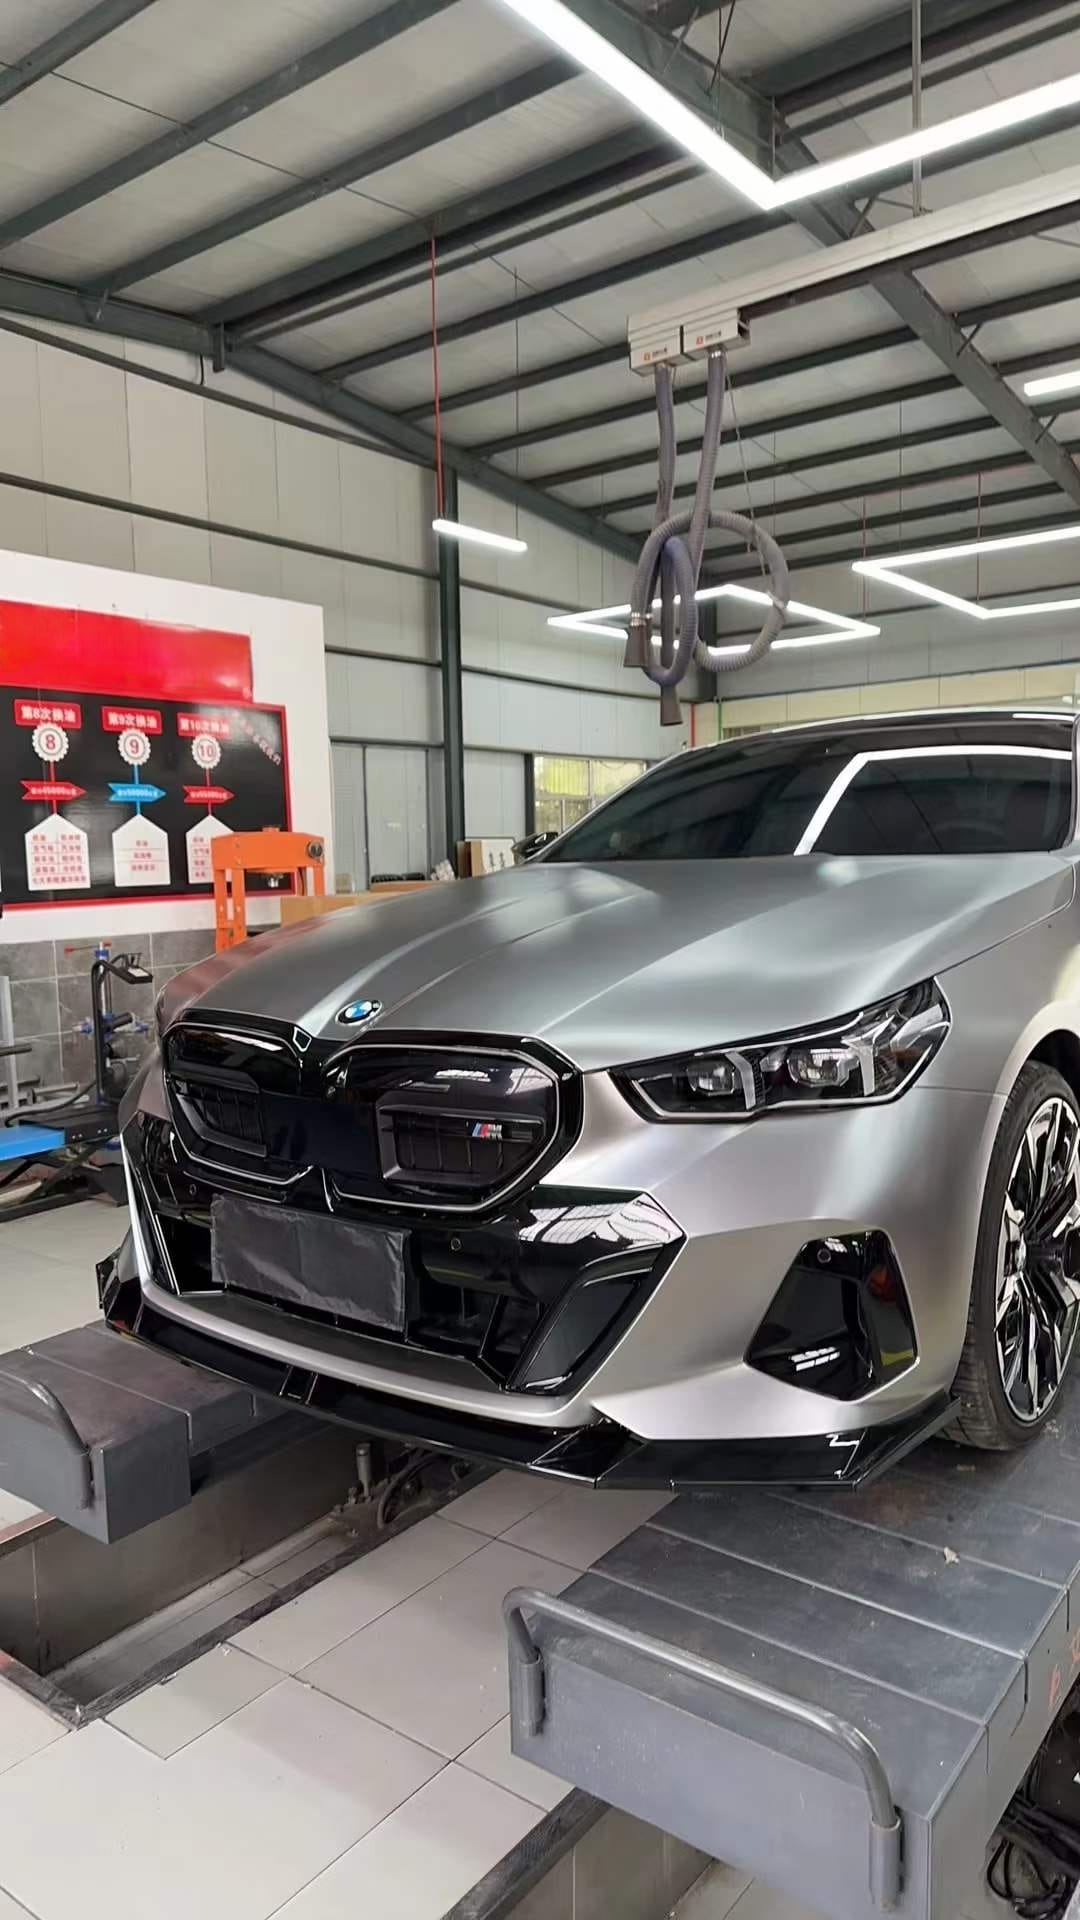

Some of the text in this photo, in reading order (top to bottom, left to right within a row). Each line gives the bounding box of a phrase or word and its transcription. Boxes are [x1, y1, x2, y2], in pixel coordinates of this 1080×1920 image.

[21, 704, 76, 723] 第8次换油
[108, 711, 158, 729] 第9次换油
[46, 734, 56, 750] 8
[129, 738, 139, 754] 9
[200, 745, 214, 757] 10
